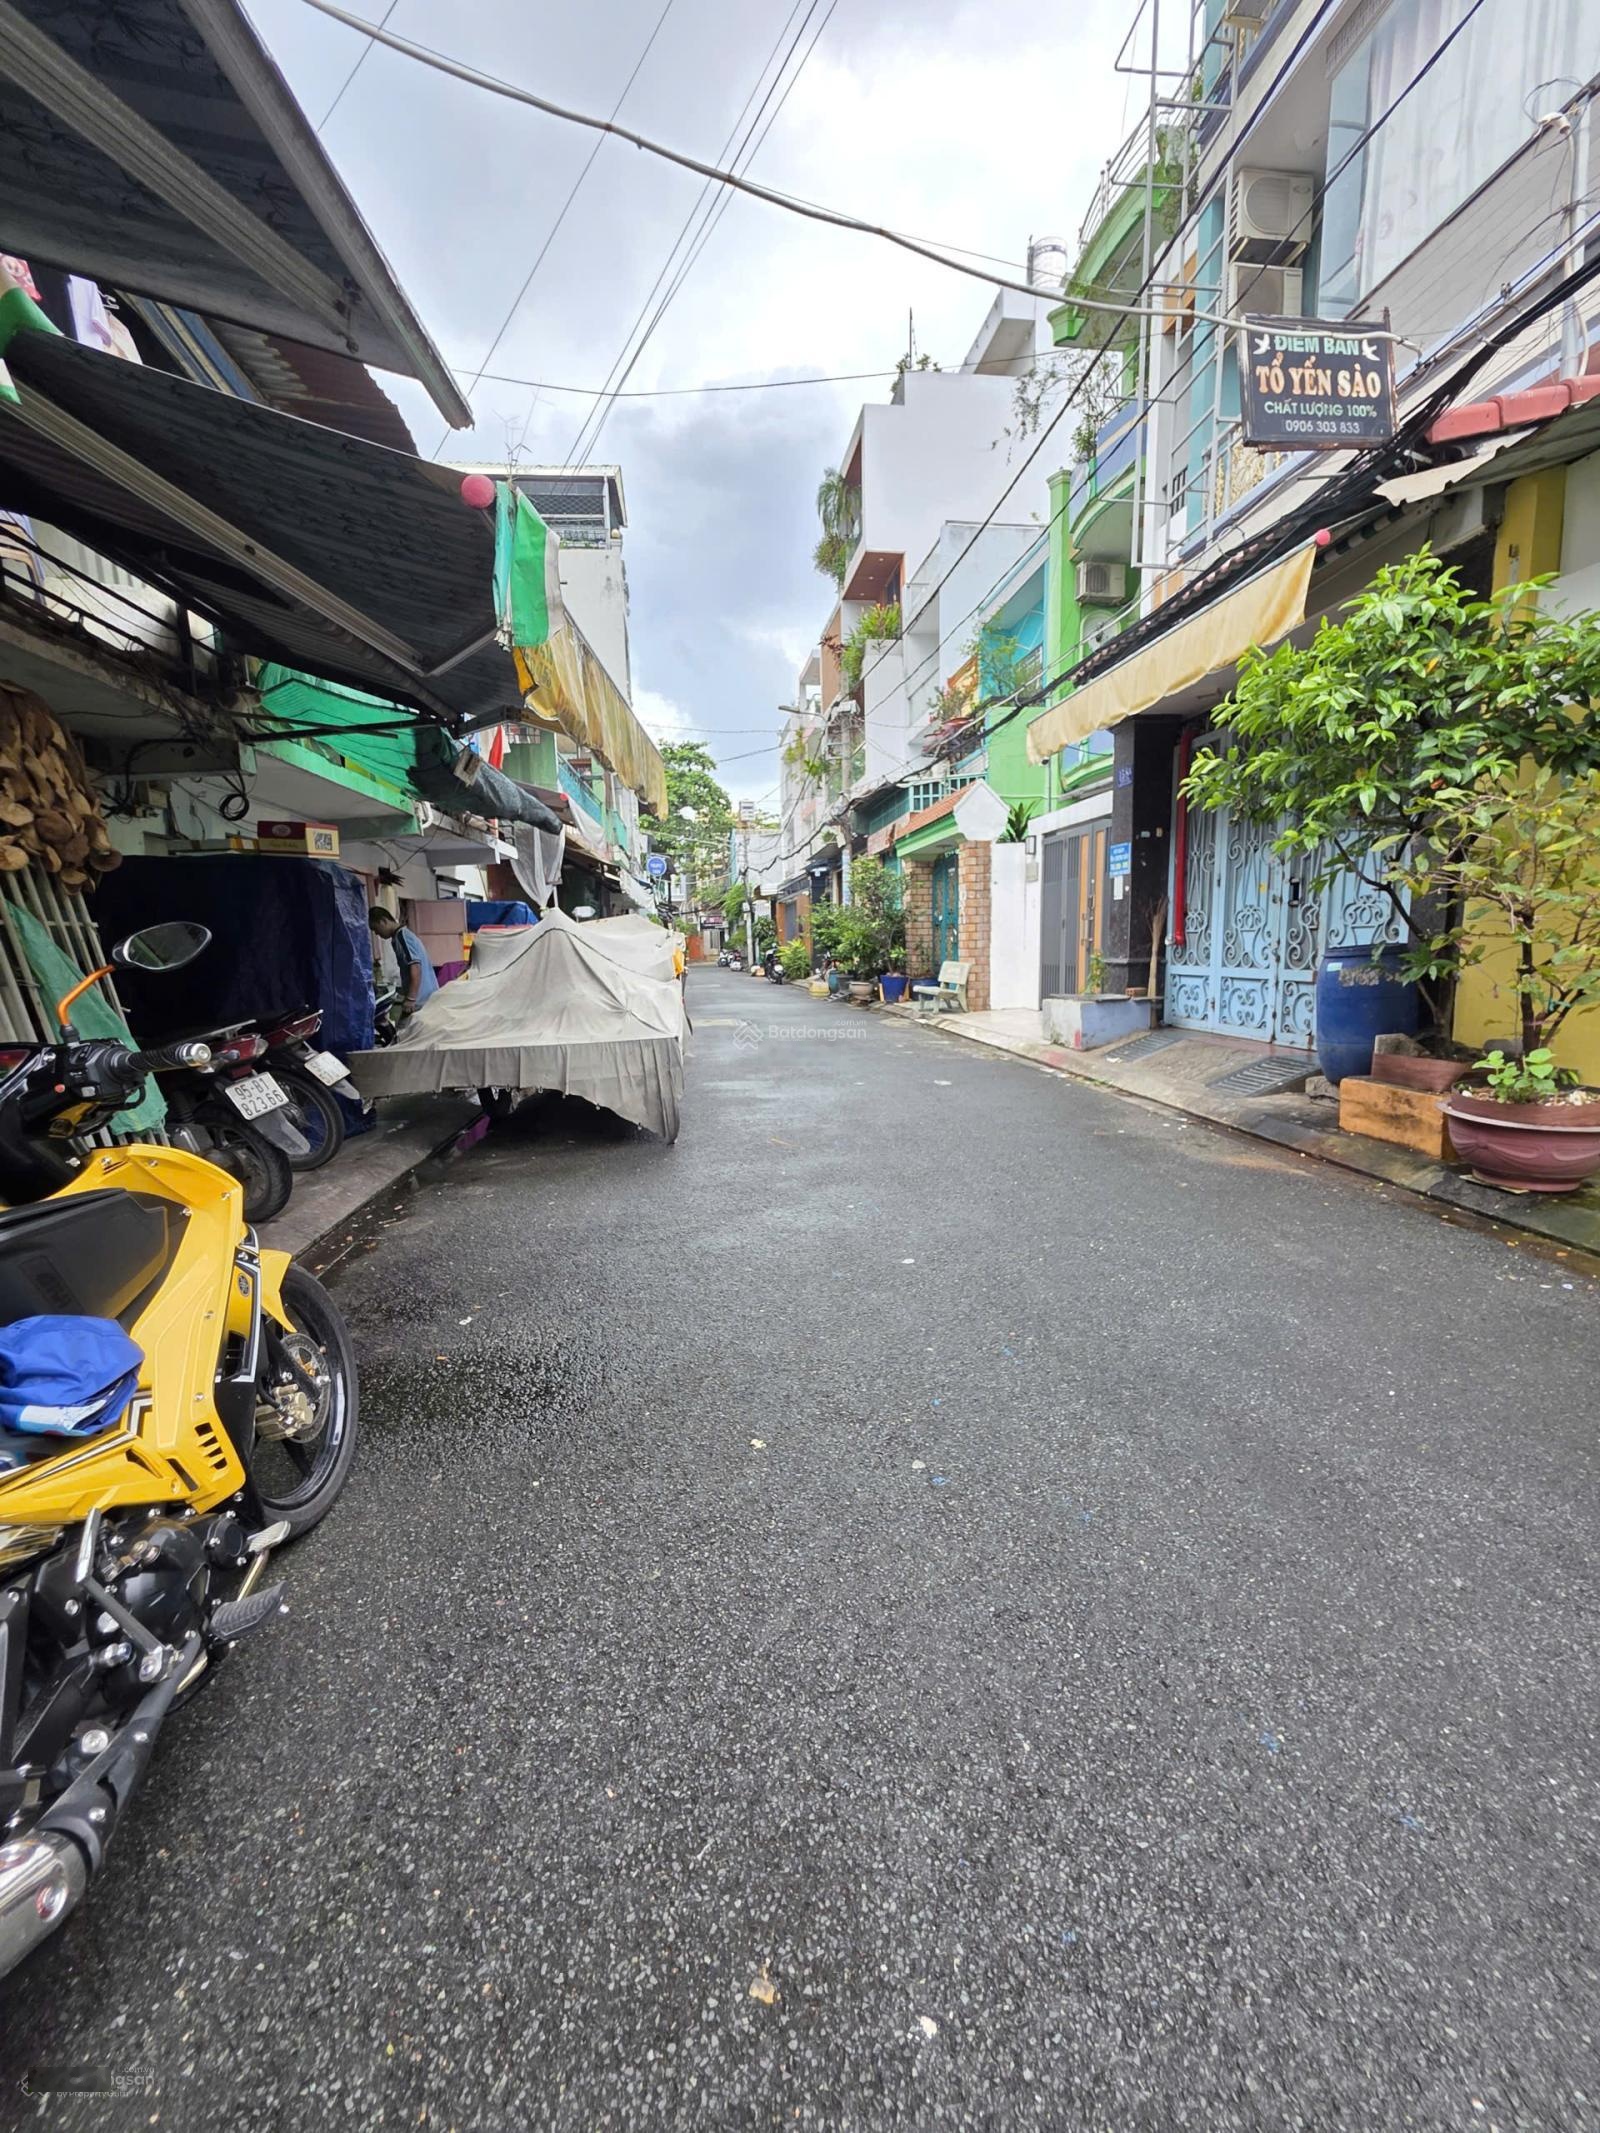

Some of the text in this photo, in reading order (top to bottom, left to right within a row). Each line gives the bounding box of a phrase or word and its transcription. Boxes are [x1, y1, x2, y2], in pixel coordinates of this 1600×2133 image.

[1256, 351, 1382, 398] TỔ YẾN SÀO
[1264, 398, 1378, 418] CHẤT LƯỢNG 100%
[1285, 419, 1361, 434] 0906 303 833
[234, 1077, 270, 1100] 95-B1
